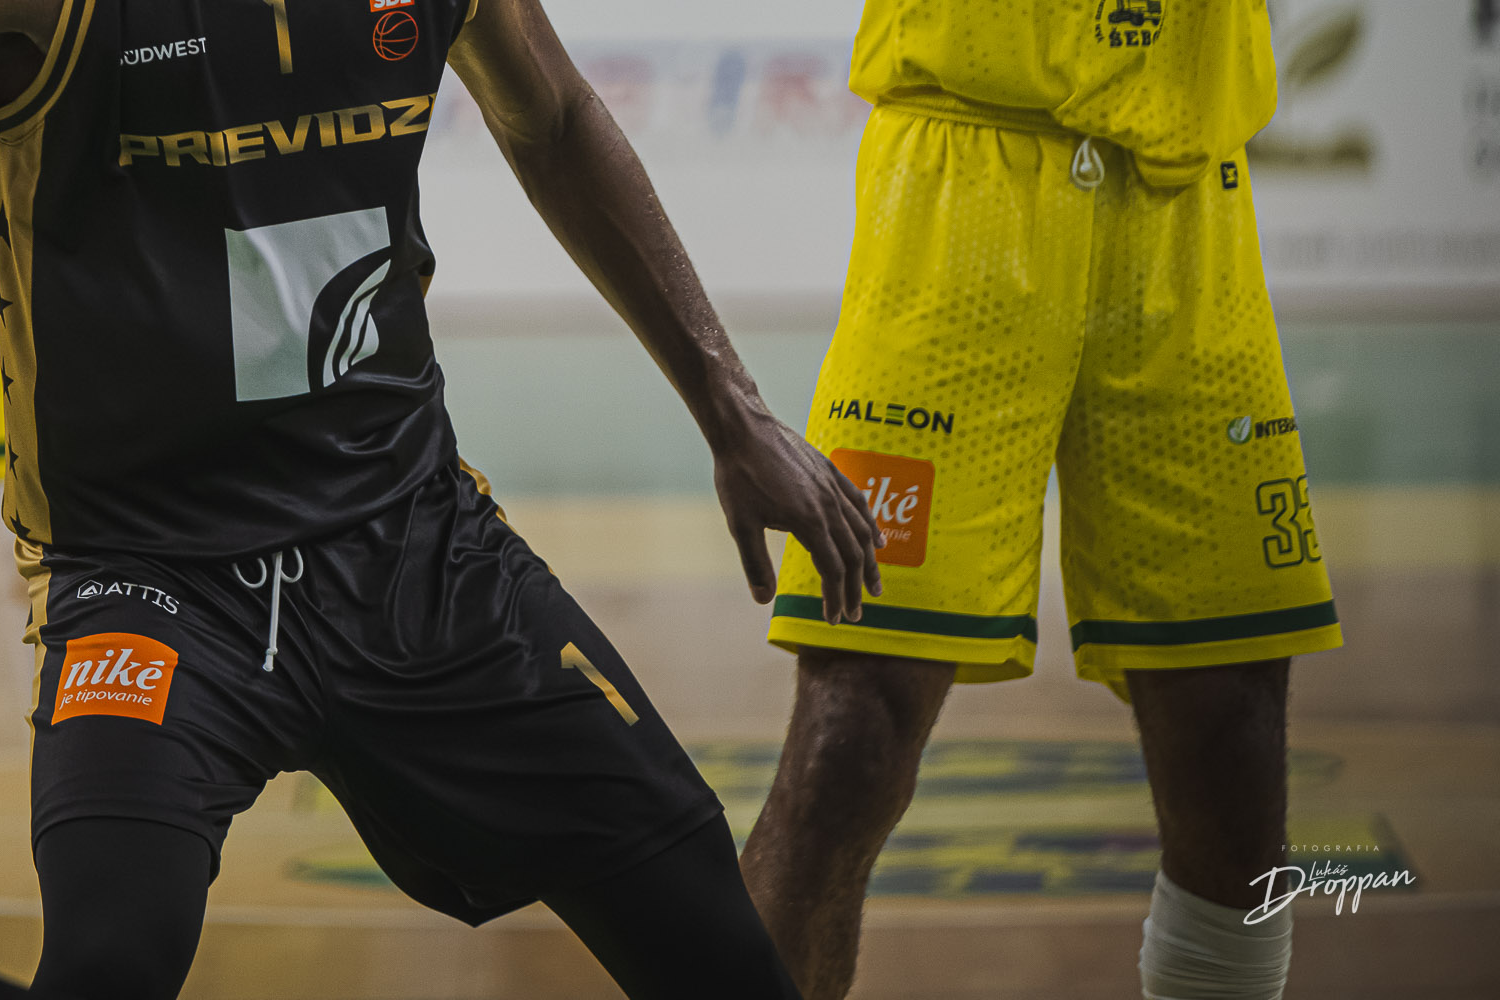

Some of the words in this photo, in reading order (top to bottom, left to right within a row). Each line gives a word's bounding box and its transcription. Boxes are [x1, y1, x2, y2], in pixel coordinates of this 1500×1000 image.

[120, 36, 207, 67] ÜDWEST
[118, 92, 437, 168] PRIEVIDZ
[829, 399, 954, 434] HALEON
[860, 476, 919, 524] iké
[104, 581, 180, 615] ATTIS
[63, 648, 165, 690] niké
[560, 641, 640, 727] 1
[58, 692, 74, 711] je
[75, 688, 153, 706] tipovanie
